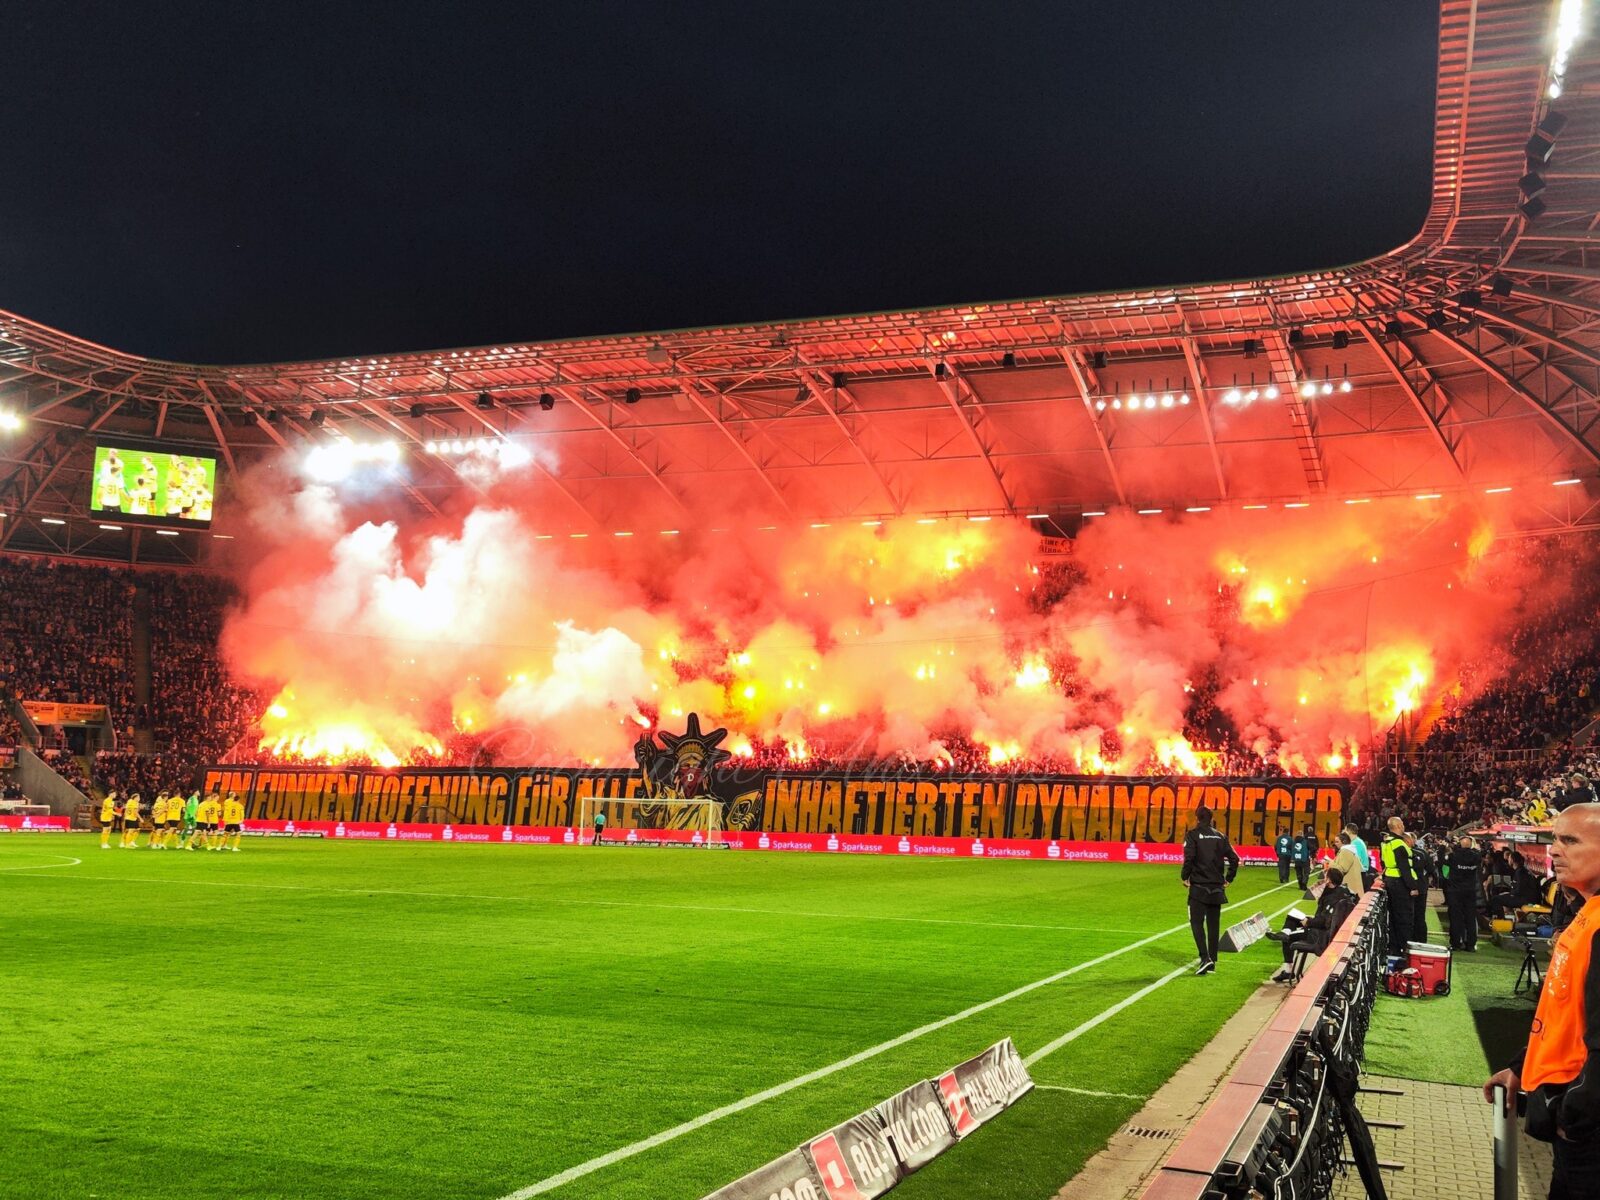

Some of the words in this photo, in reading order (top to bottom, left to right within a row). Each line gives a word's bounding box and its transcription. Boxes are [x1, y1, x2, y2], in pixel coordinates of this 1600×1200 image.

[252, 773, 358, 822] FUNKEN
[360, 774, 508, 825] HOFFNUNG
[572, 778, 643, 829] ALLE
[762, 779, 1007, 838] INHAFTIERTEN
[1012, 783, 1343, 847] DYNAMOKRIEGER
[347, 829, 381, 838] Sparkasse
[398, 831, 433, 839] Sparkasse
[455, 832, 490, 841] Sparkasse
[514, 834, 550, 842] Sparkasse
[773, 840, 812, 849] Sparkasse
[842, 842, 882, 851] Sparkasse
[913, 844, 956, 854] Sparkasse
[987, 847, 1031, 856] Sparkasse
[1063, 849, 1109, 859] Sparkasse
